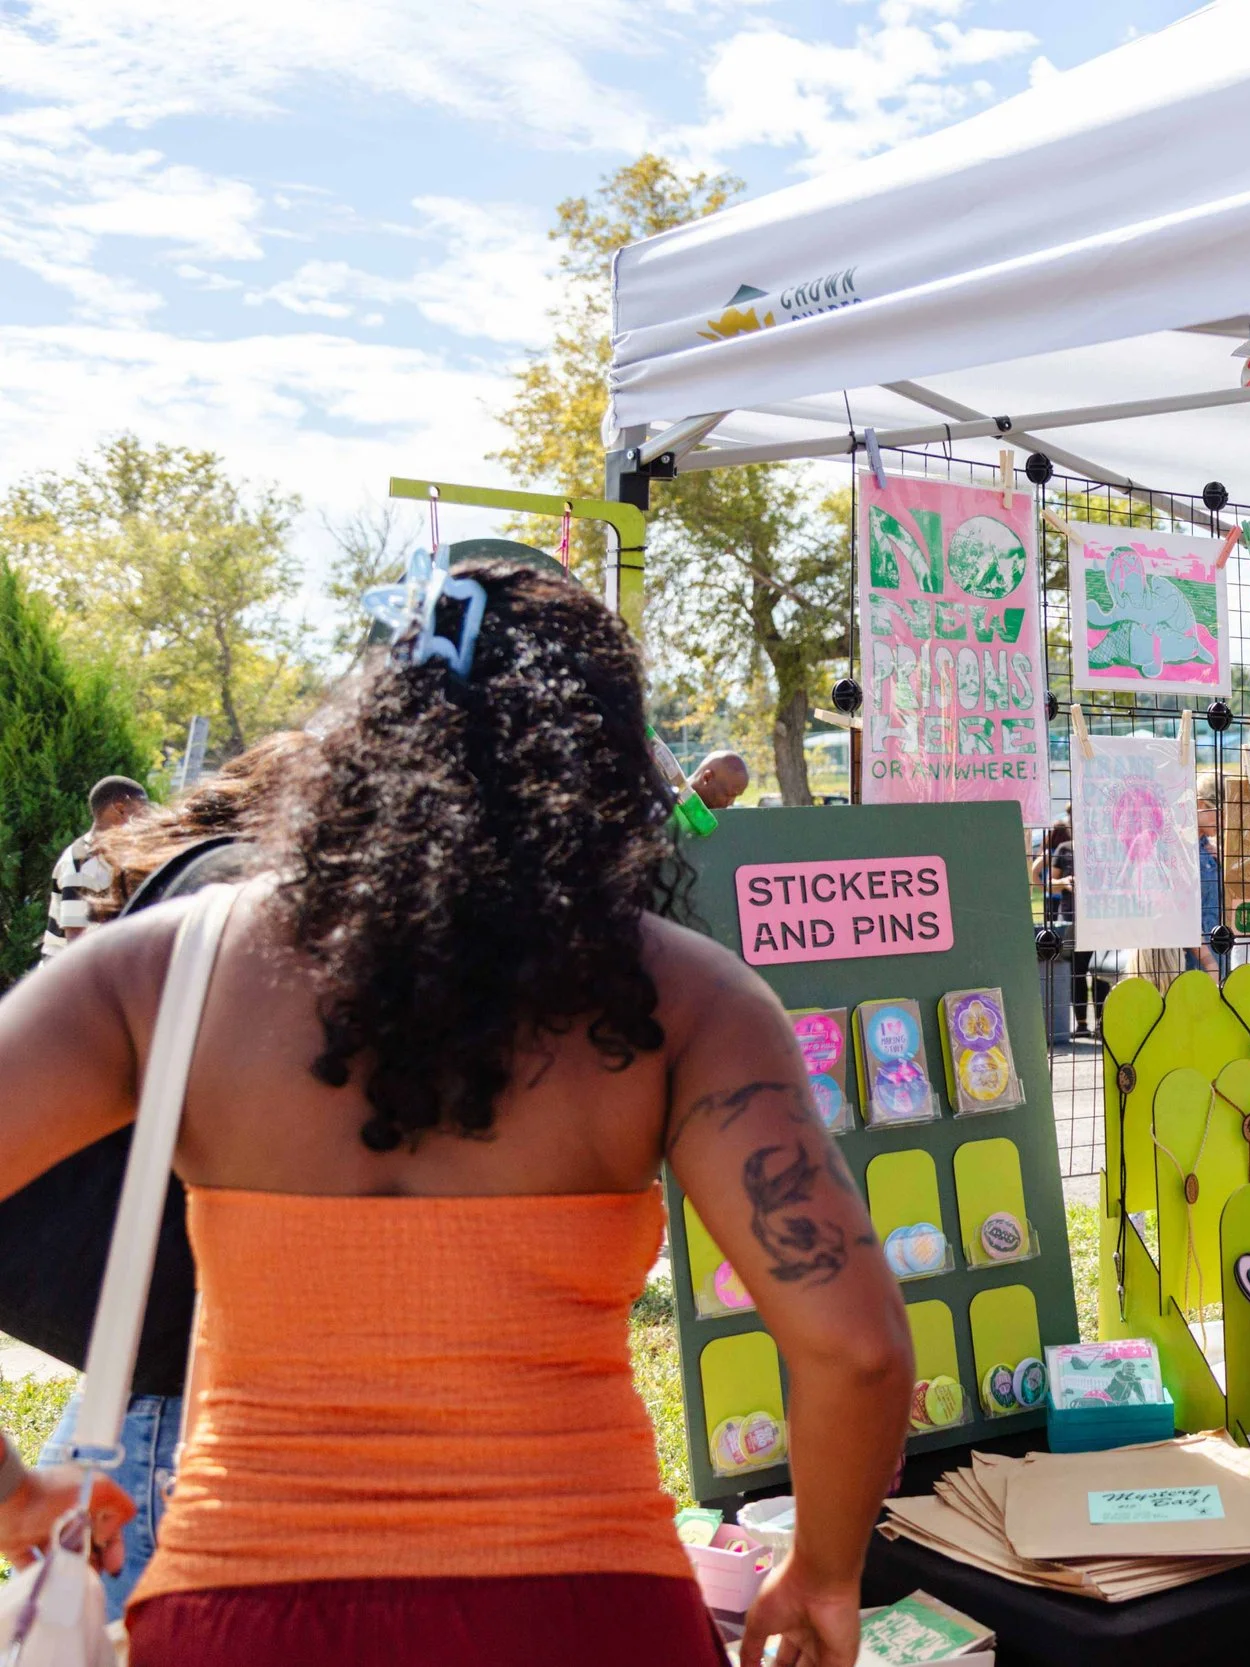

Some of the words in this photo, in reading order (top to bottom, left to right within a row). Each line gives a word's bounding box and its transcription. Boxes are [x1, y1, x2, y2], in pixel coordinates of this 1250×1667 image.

[780, 266, 858, 310] CROWN
[868, 505, 1027, 600] NO
[868, 593, 1026, 643] NEW
[872, 640, 1035, 712] PRISONS
[872, 714, 1037, 755] HERE
[872, 760, 902, 780] OR
[911, 760, 1037, 781] ANYWHERE!
[748, 867, 940, 907] STICKERS
[753, 919, 835, 952] AND
[852, 911, 940, 945] PINS
[1102, 1489, 1201, 1501] Mystery
[1151, 1493, 1211, 1507] Bag!
